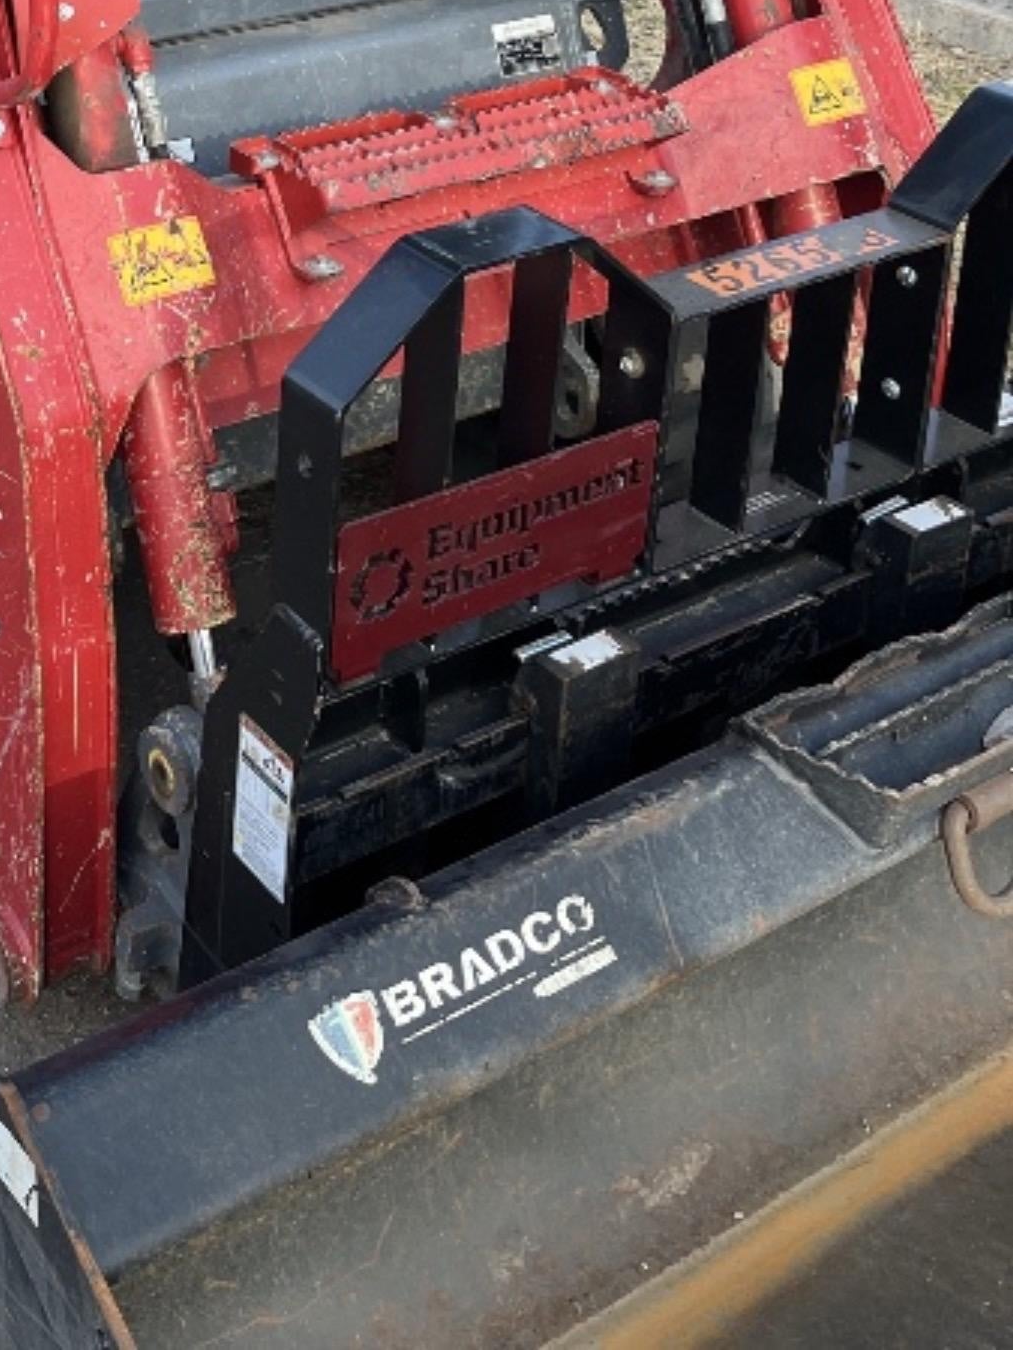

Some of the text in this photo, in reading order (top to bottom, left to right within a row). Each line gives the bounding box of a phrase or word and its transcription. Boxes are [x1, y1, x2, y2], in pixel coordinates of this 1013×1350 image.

[426, 457, 646, 560] Equipment
[421, 543, 540, 605] Share
[380, 893, 595, 1027] BRADCO
